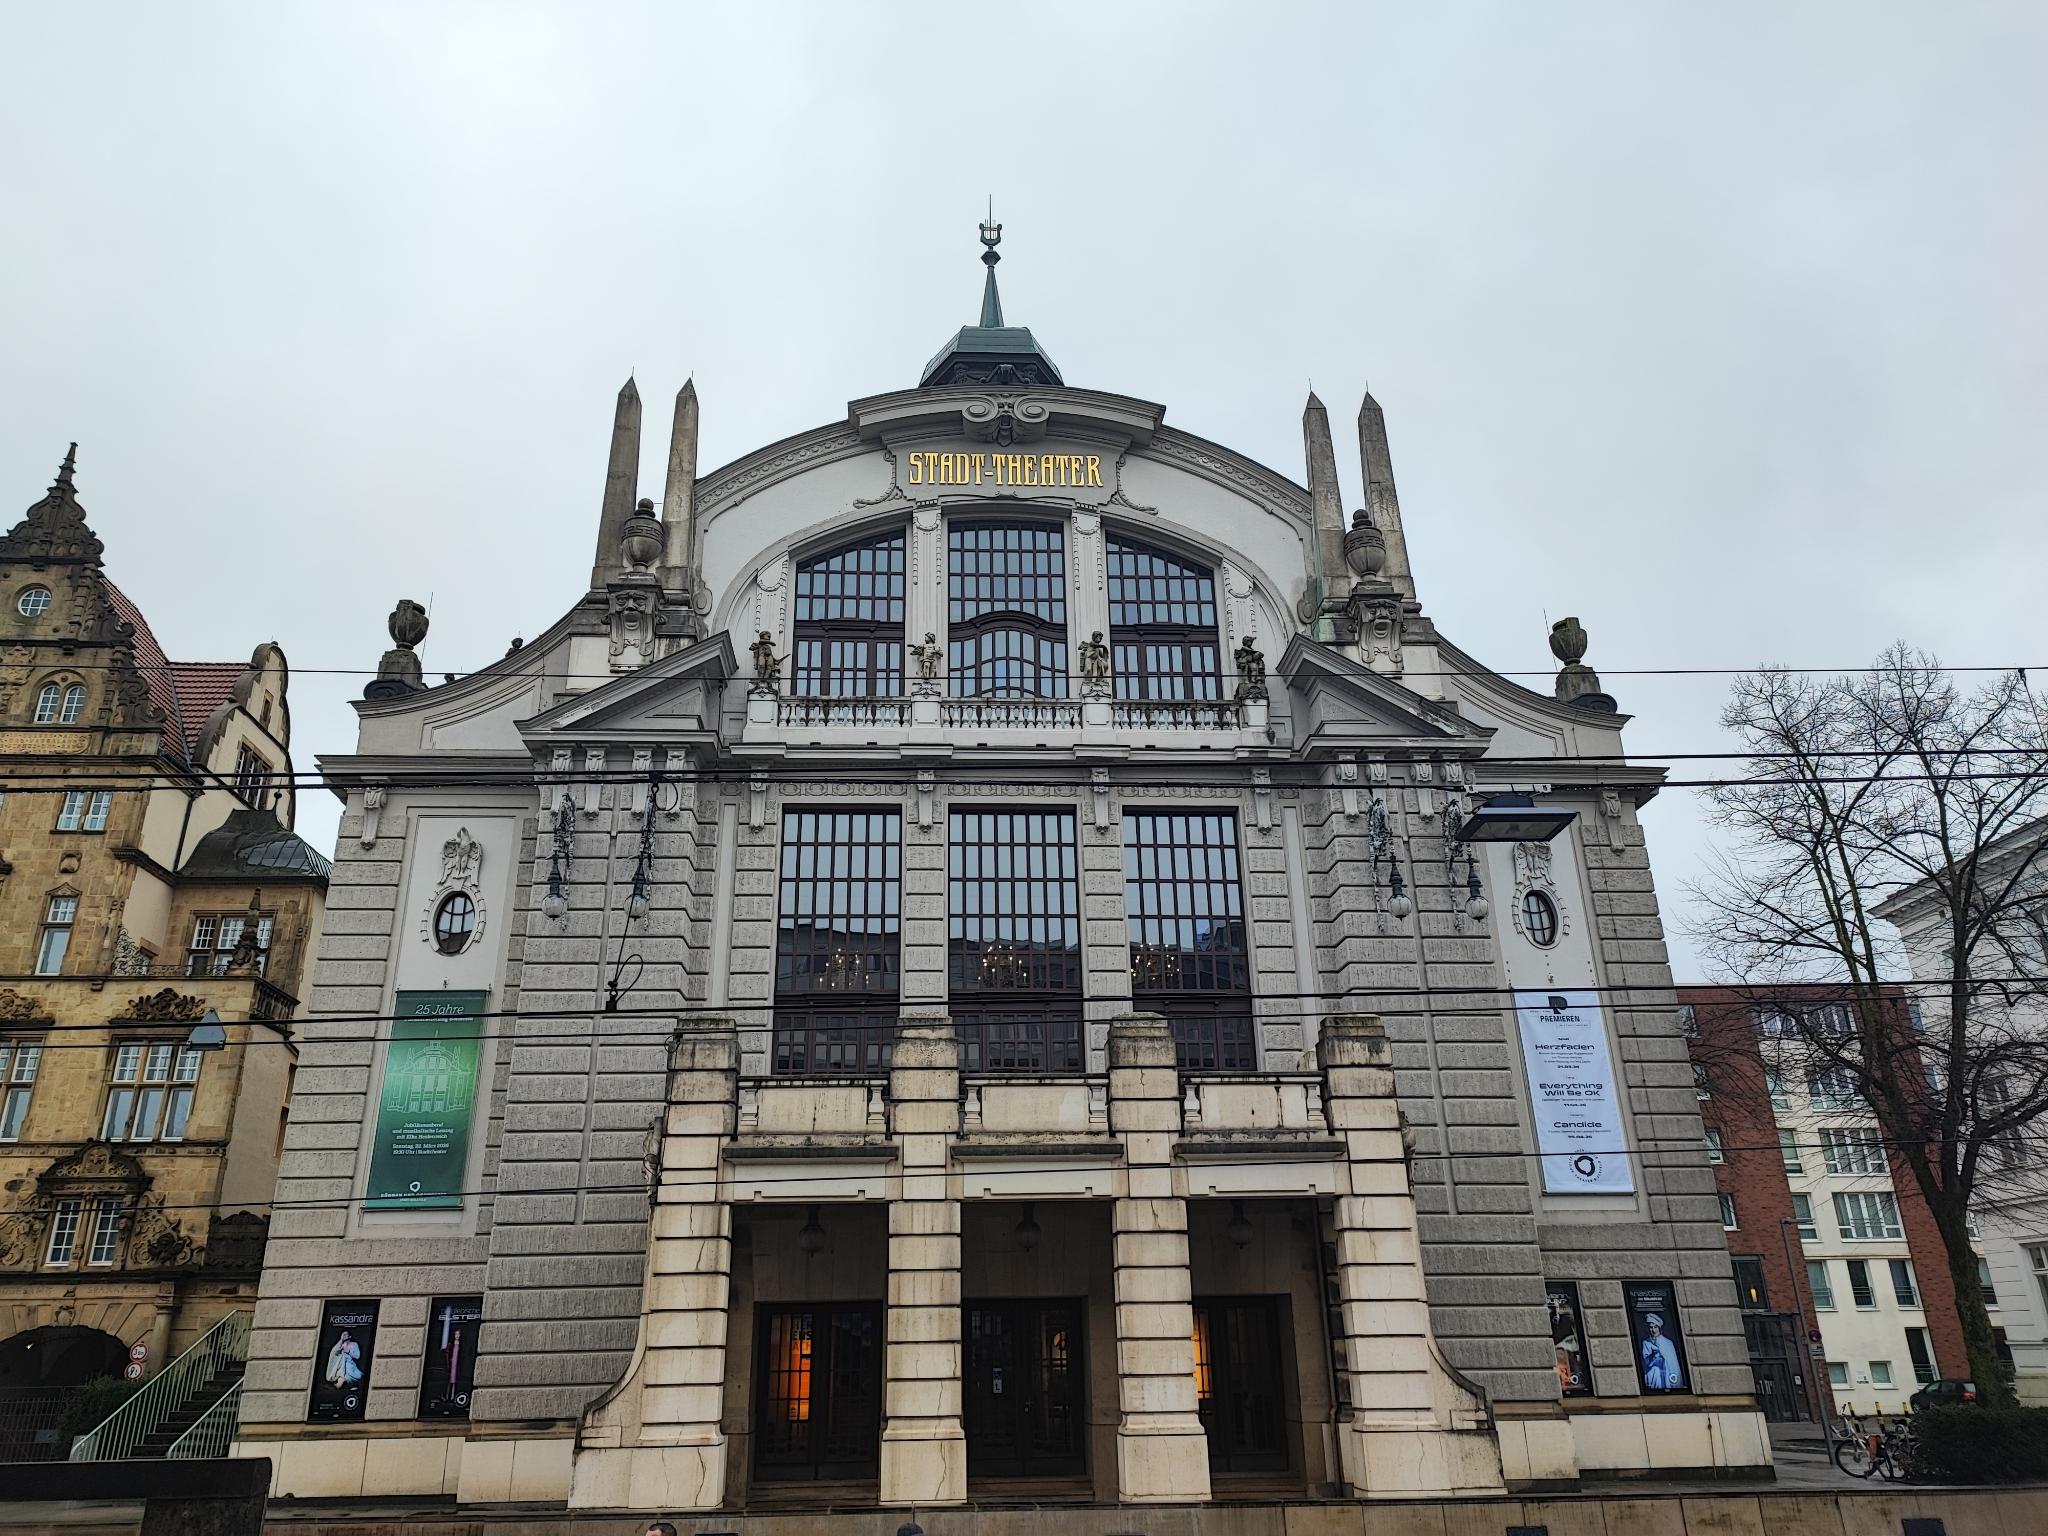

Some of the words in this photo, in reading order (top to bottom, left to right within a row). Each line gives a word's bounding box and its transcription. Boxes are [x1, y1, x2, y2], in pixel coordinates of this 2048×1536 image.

[909, 452, 1104, 487] STADT-THEATER
[415, 1004, 431, 1015] 25
[432, 1004, 464, 1015] Jahre
[330, 1313, 373, 1323] Kassandra
